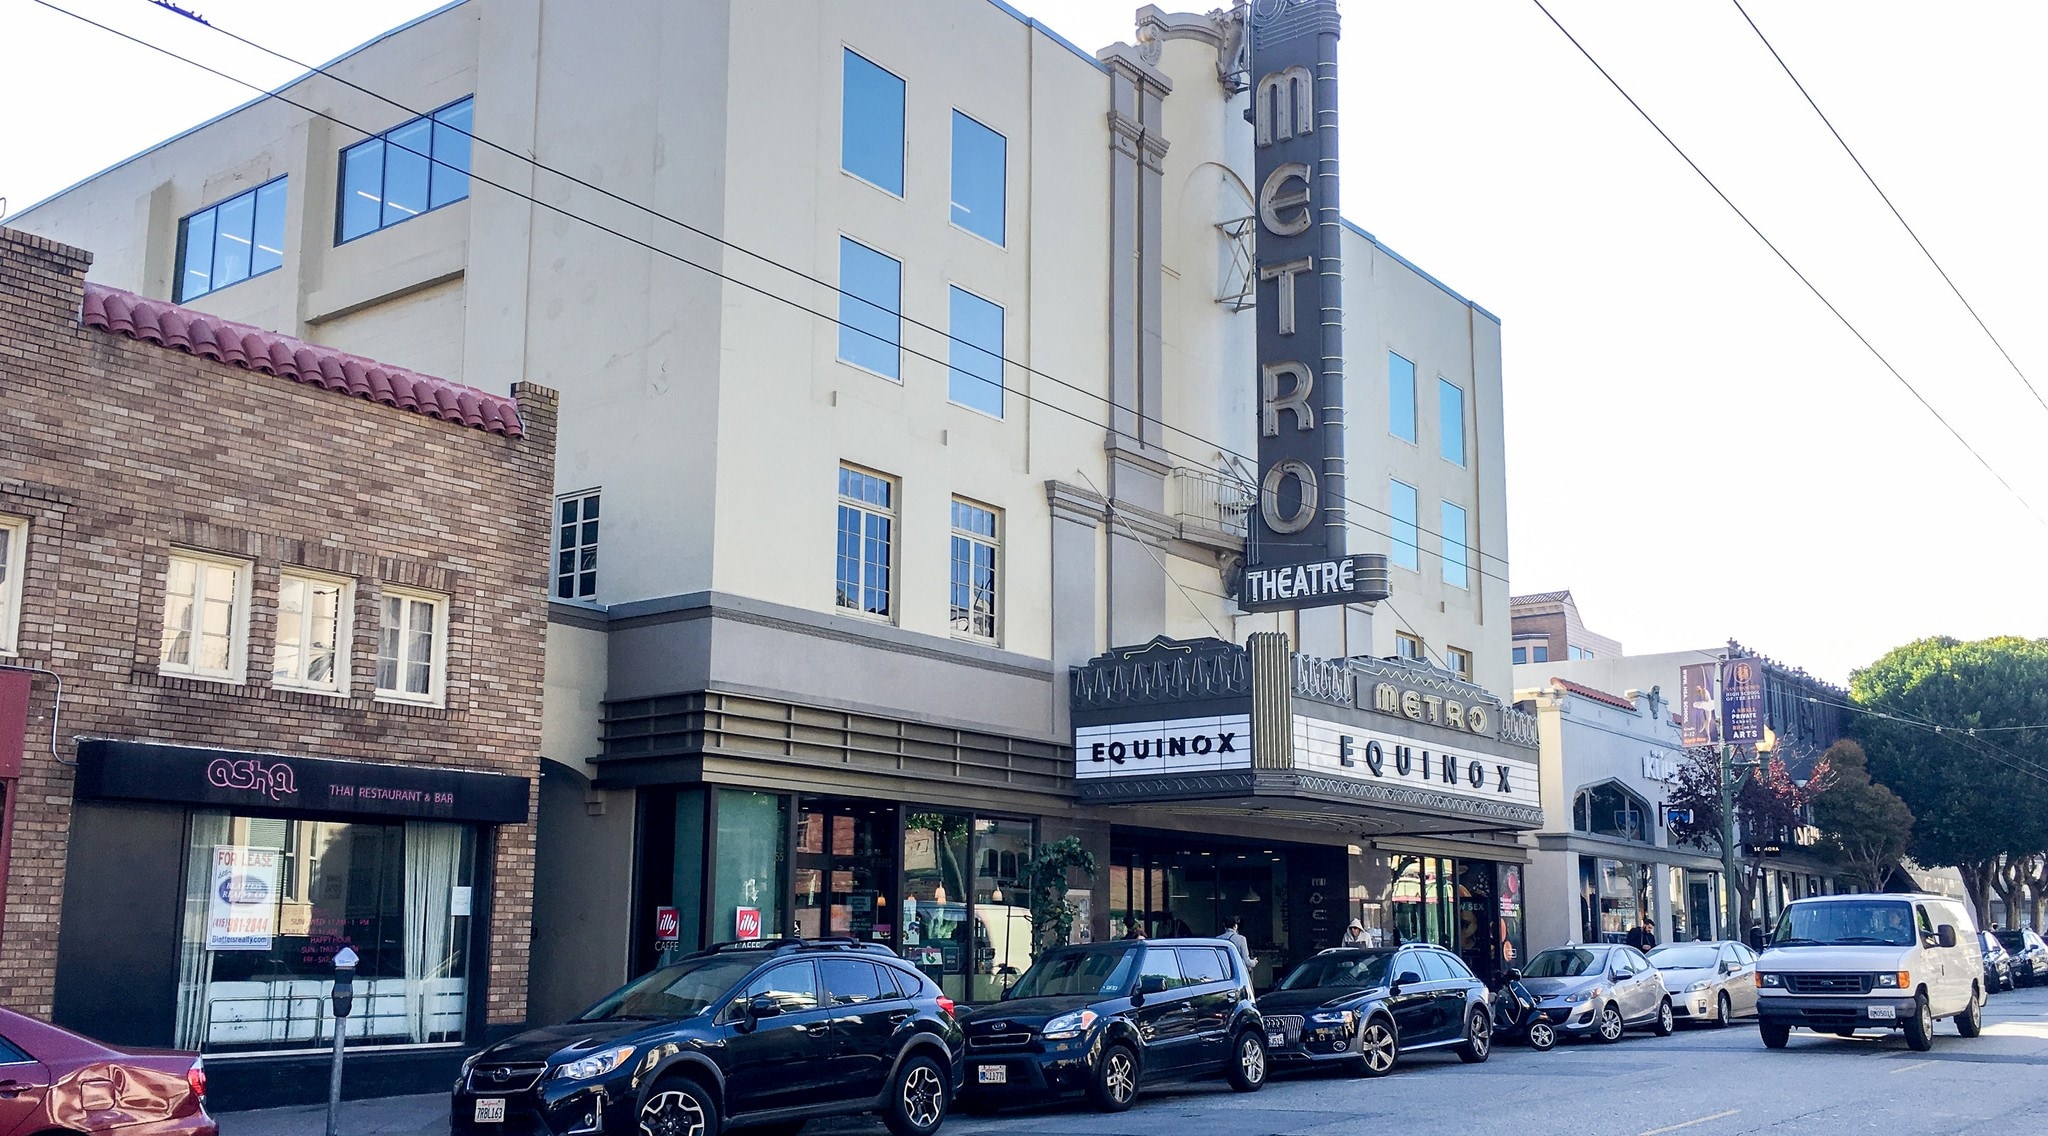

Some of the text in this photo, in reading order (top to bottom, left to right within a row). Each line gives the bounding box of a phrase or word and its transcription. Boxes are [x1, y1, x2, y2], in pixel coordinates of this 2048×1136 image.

[1255, 65, 1320, 536] METRO
[1247, 557, 1355, 603] THEATRE
[1374, 682, 1488, 735] METRO
[1733, 730, 1757, 739] ARTS
[1091, 732, 1237, 766] EQUINOX
[1340, 735, 1513, 794] EQUINOX
[328, 784, 454, 804] THAI RESTAURANT & BAR
[217, 851, 273, 867] FOR LEASE
[1468, 903, 1485, 911] SEX
[659, 913, 677, 935] illy
[740, 913, 758, 935] illy
[310, 936, 352, 944] HAPPY HOUR
[654, 941, 679, 952] CAFFE
[477, 1107, 503, 1119] 7RBL163
